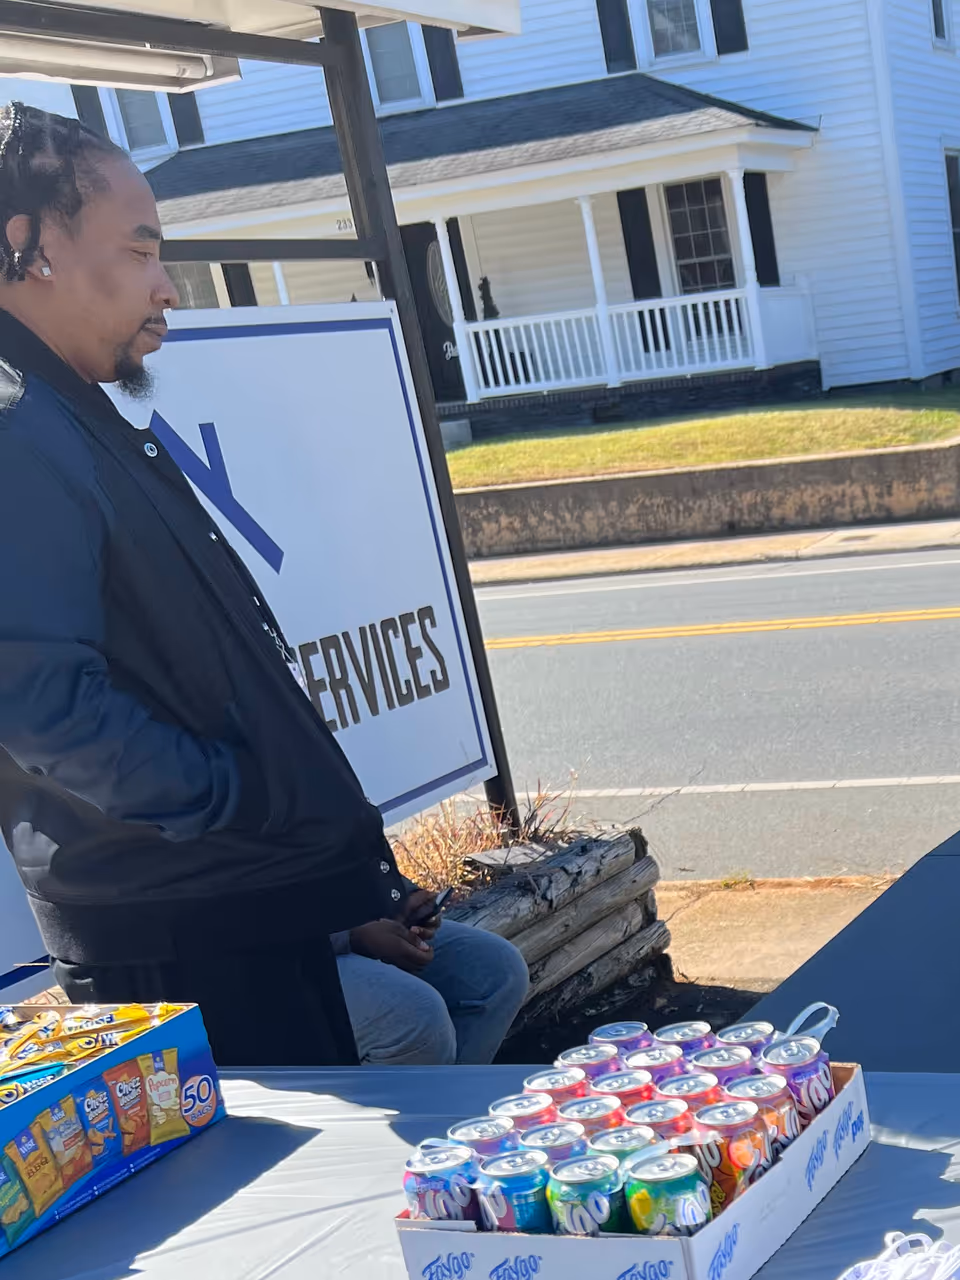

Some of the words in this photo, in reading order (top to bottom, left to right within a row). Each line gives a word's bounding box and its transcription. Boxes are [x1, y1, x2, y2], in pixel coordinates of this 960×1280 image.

[297, 605, 450, 733] ERVICES
[183, 1076, 213, 1115] 50
[190, 1103, 213, 1122] BAGS
